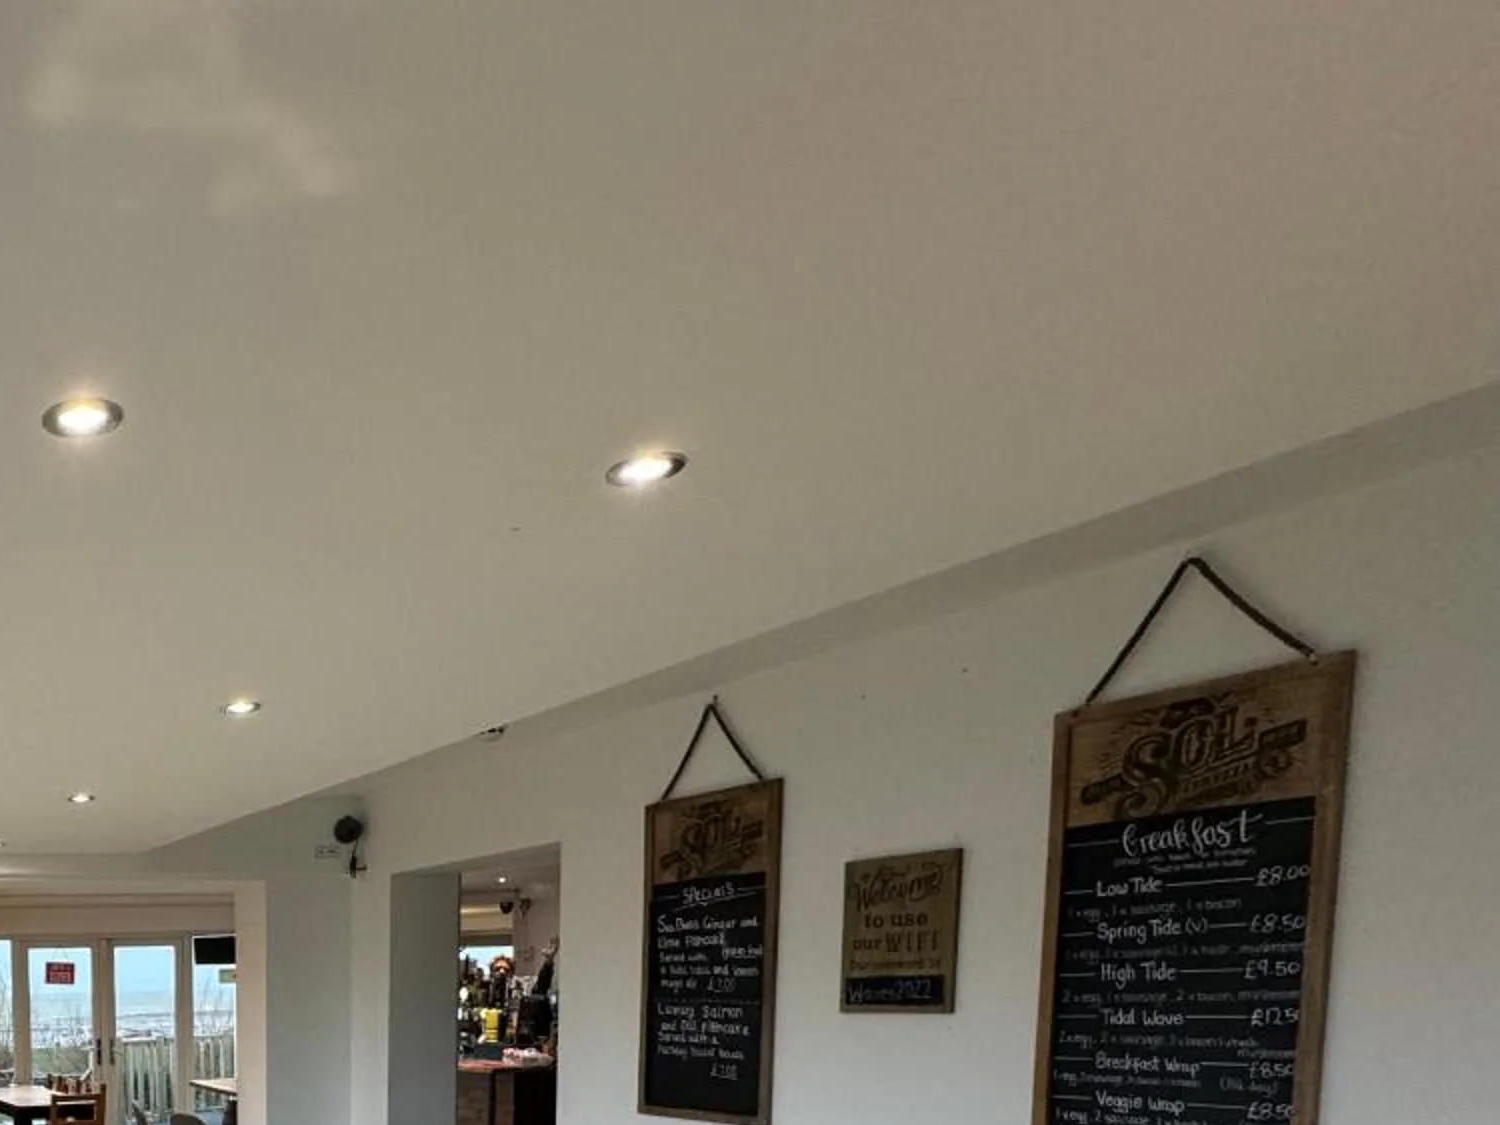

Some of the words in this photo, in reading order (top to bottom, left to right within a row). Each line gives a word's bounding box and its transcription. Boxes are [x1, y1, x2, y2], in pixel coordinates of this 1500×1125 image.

[1096, 880, 1129, 897] Low
[1132, 876, 1164, 895] Tide
[1255, 865, 1311, 887] £8.00
[865, 912, 884, 928] to
[891, 912, 928, 927] use
[1097, 920, 1148, 944] Spring
[1149, 917, 1182, 936] Tide
[1250, 912, 1306, 934] £8.50
[853, 937, 882, 951] our
[1101, 962, 1136, 989] High
[1141, 961, 1177, 981] Tide
[1243, 958, 1301, 980] £9.50
[1100, 1007, 1136, 1025] Tidal
[1142, 1008, 1185, 1026] Wave
[1164, 1055, 1202, 1080] Wrap
[1095, 1089, 1143, 1113] Veggie
[1148, 1095, 1186, 1117] Wrap
